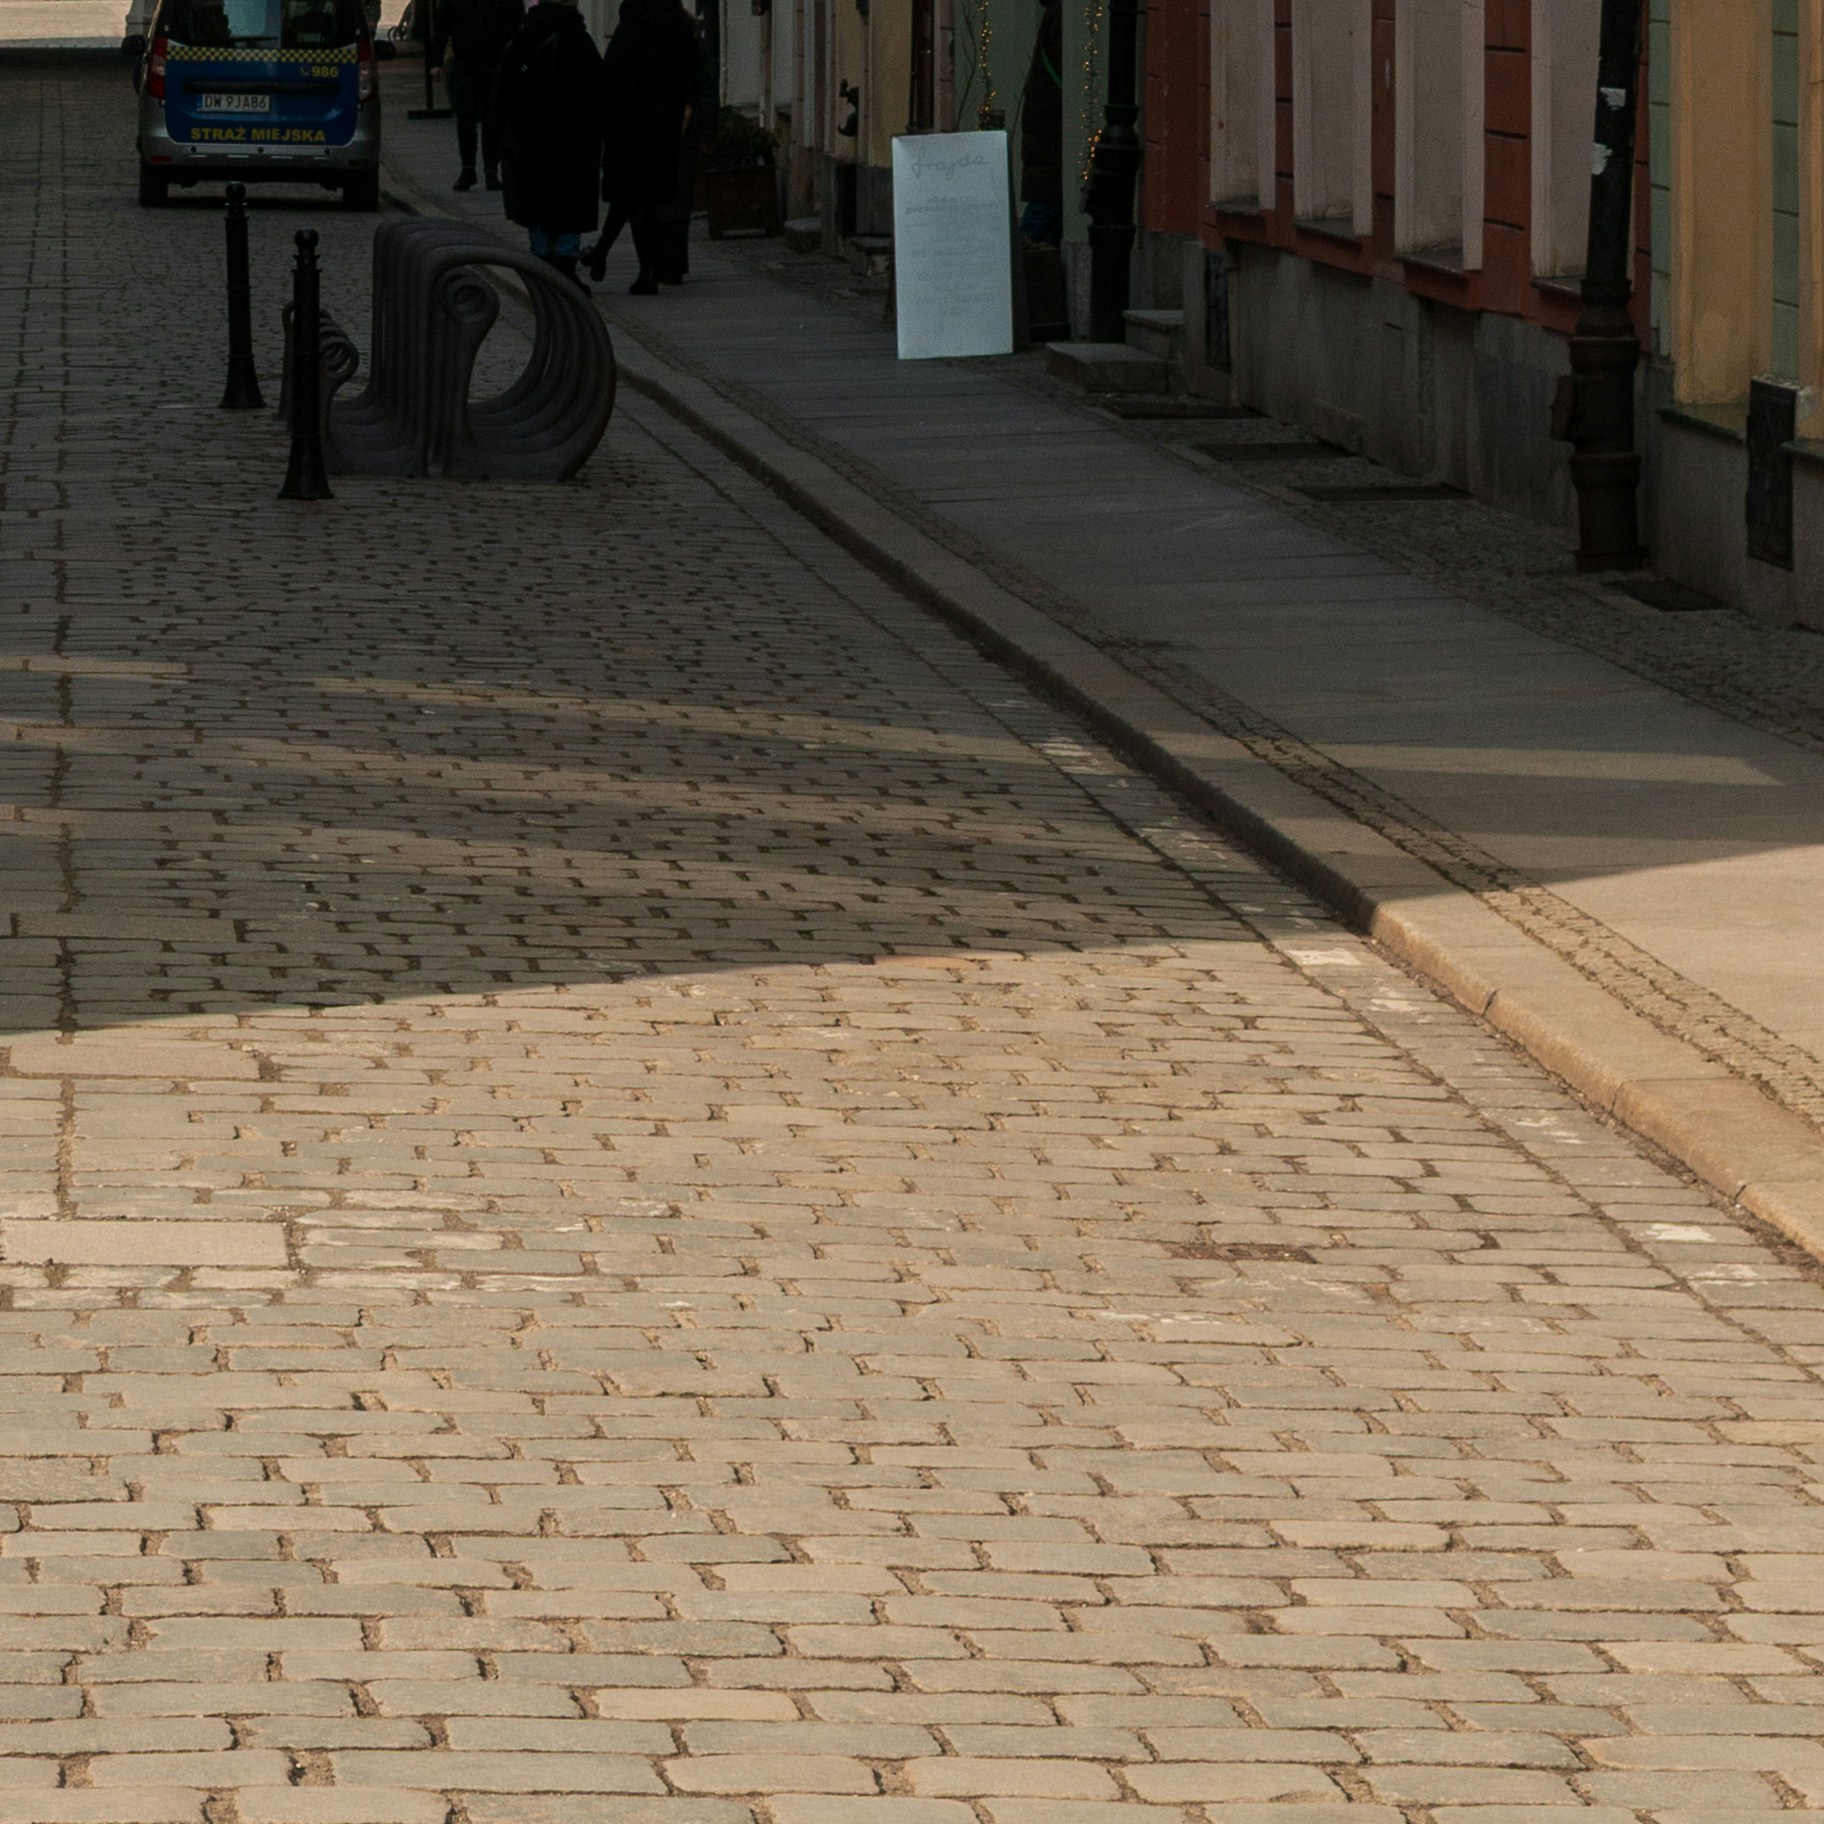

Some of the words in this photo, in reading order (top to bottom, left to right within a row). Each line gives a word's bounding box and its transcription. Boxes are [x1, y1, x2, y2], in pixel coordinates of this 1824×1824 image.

[311, 66, 338, 78] 986
[204, 95, 222, 109] DW
[226, 95, 267, 109] 9JA86
[190, 125, 247, 141] STRAŻ
[251, 128, 326, 142] MIEJSKA
